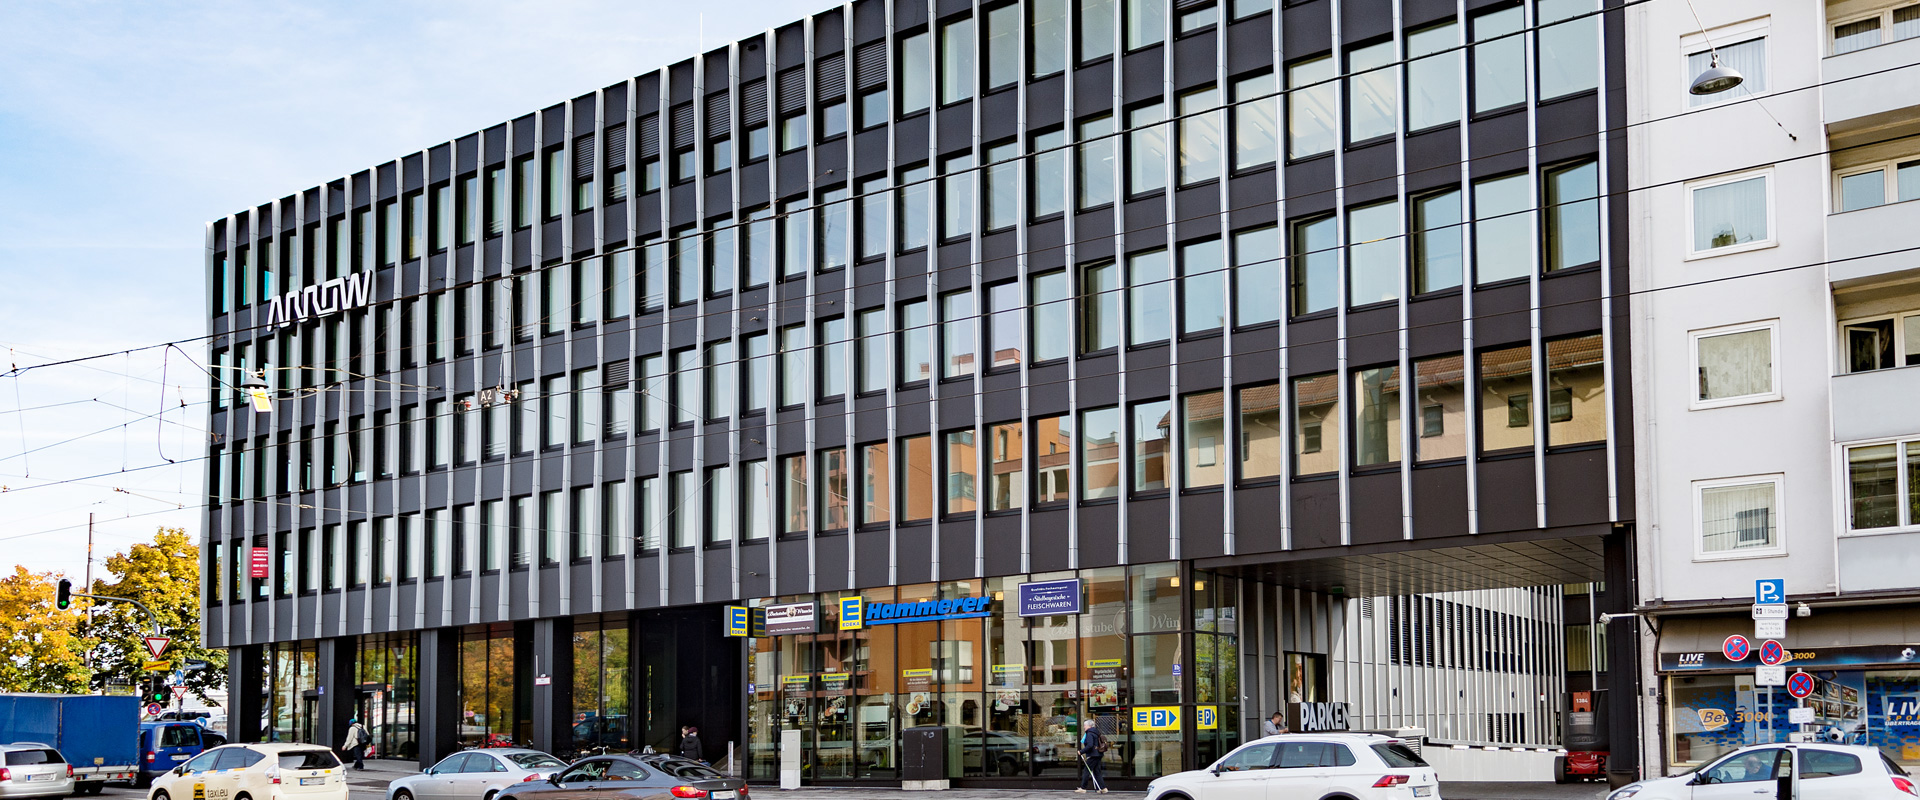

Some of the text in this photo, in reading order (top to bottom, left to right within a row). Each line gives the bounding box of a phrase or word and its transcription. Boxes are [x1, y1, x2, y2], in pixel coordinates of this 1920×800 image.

[266, 268, 372, 332] ARROW
[480, 389, 492, 401] A2
[1759, 582, 1776, 602] P
[865, 596, 990, 620] Hammerer
[1027, 600, 1073, 611] FLEISCHWAREN
[1679, 653, 1705, 662] LIVE
[1793, 652, 1816, 660] 3000
[1300, 701, 1351, 733] PARKEN
[1702, 711, 1727, 723] Bet
